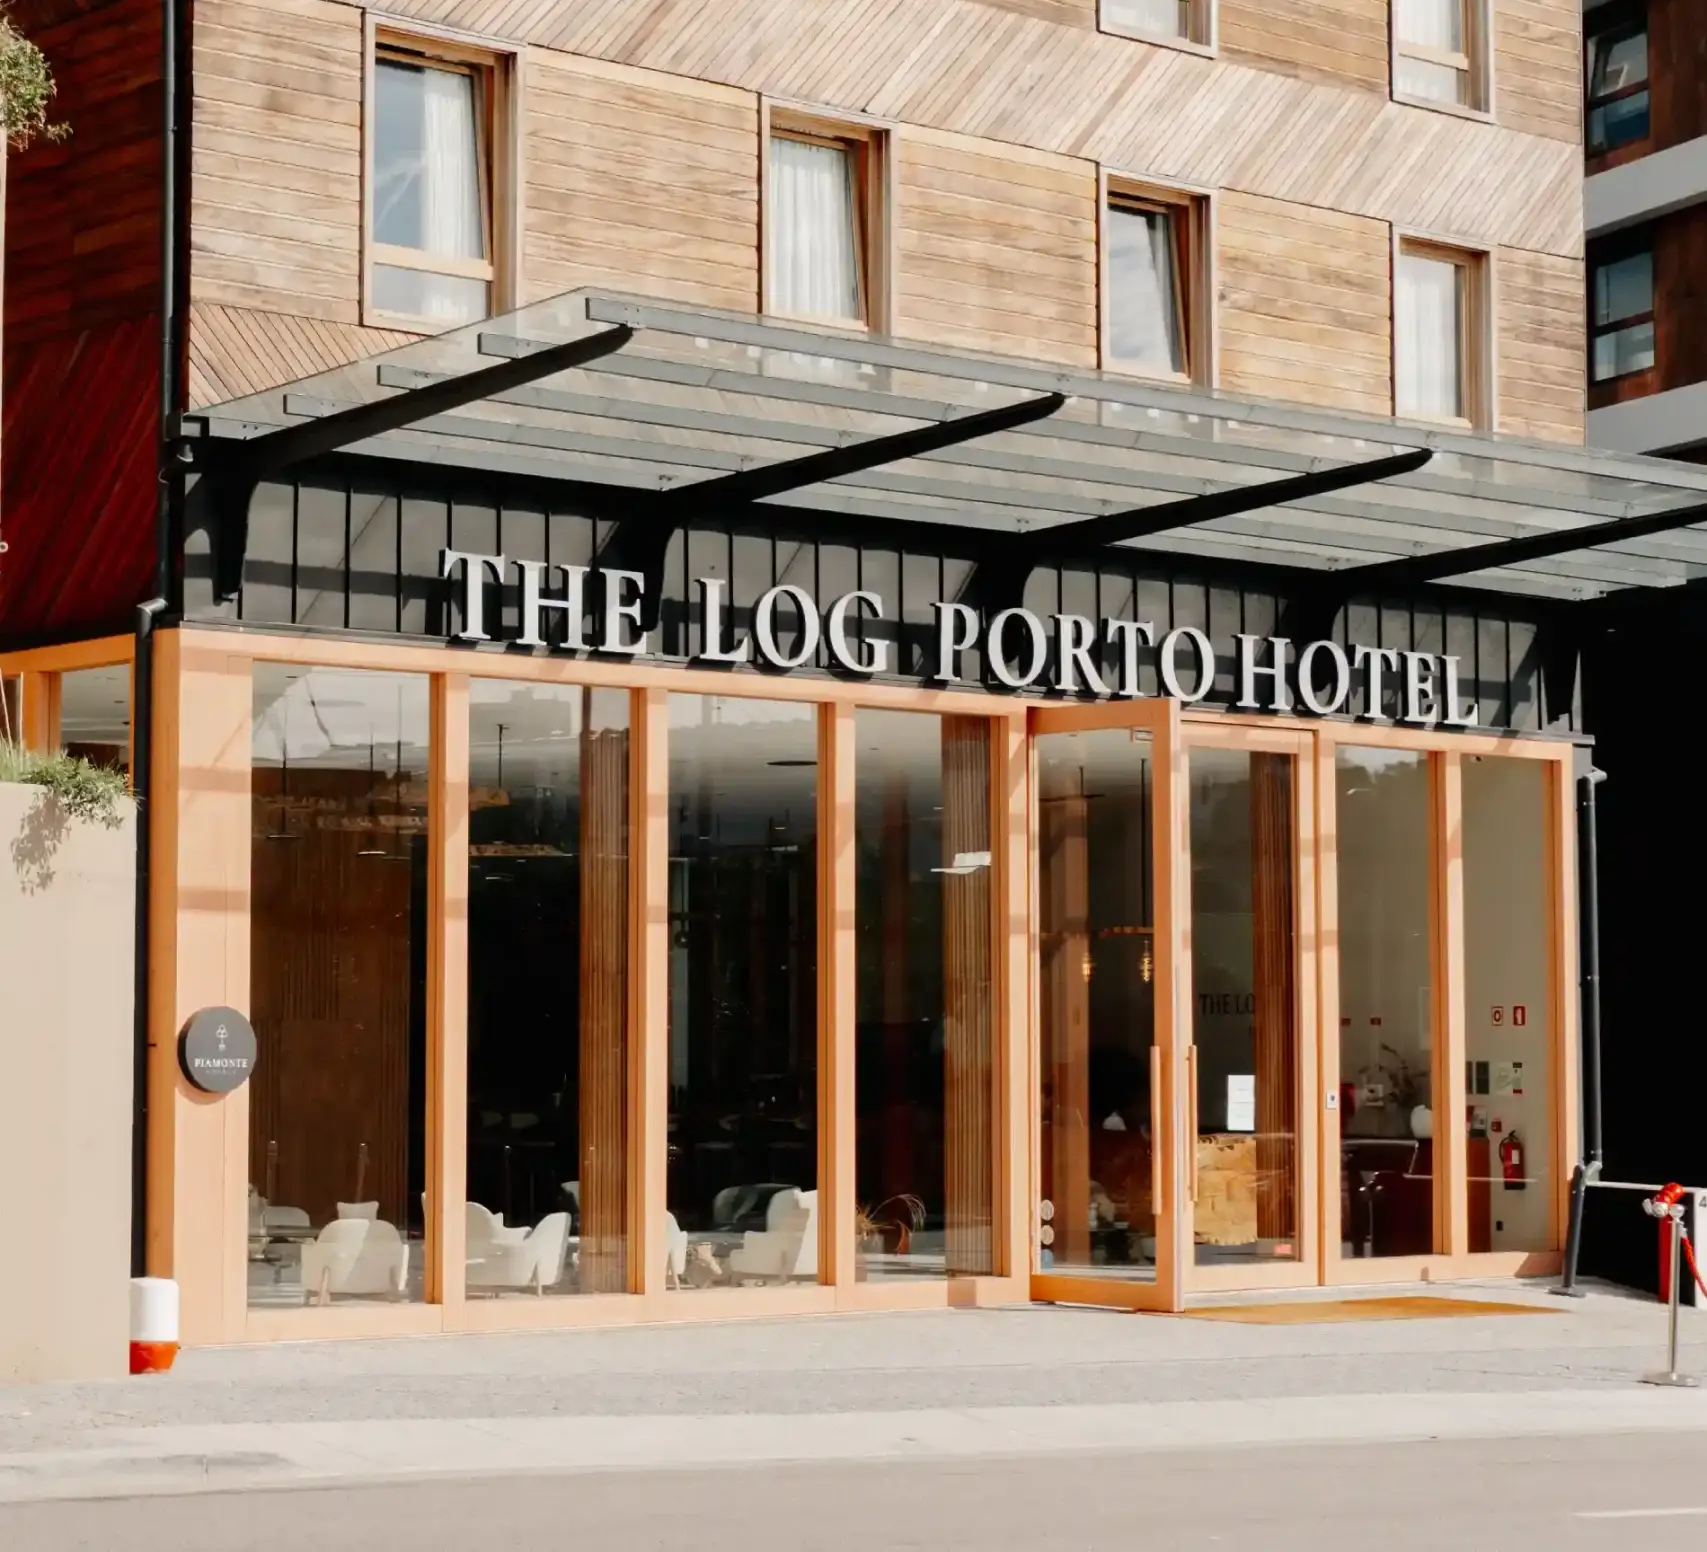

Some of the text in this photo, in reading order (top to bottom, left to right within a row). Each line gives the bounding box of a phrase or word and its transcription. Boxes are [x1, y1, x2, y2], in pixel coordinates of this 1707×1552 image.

[444, 548, 1478, 726] THE LOG PORTO HOTEL
[1199, 992, 1230, 1016] THE
[194, 1058, 249, 1068] PIAMONTE
